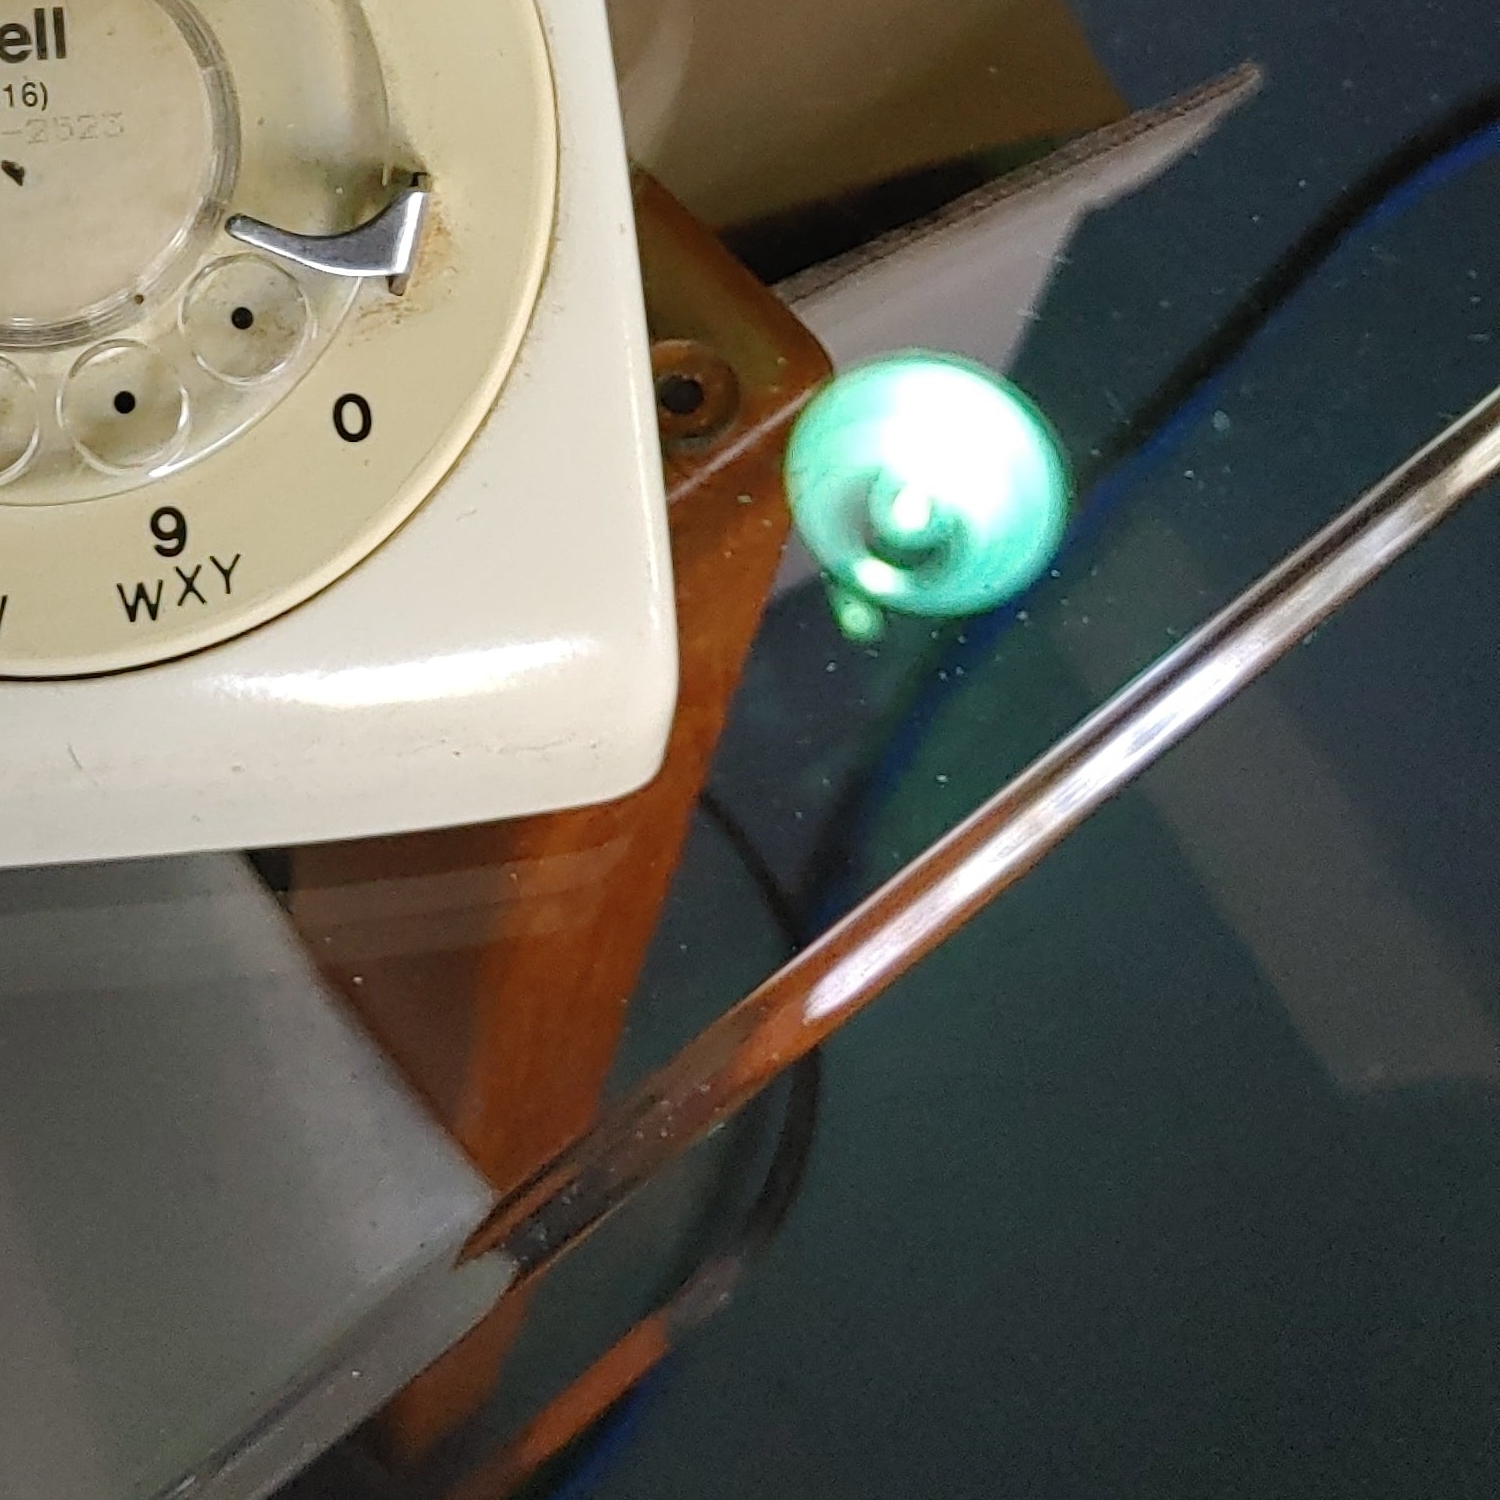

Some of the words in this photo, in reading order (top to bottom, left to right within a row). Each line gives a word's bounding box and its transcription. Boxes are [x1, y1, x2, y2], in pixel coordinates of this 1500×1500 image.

[332, 393, 372, 443] 0
[149, 506, 188, 557] 9
[116, 553, 241, 622] WXY
